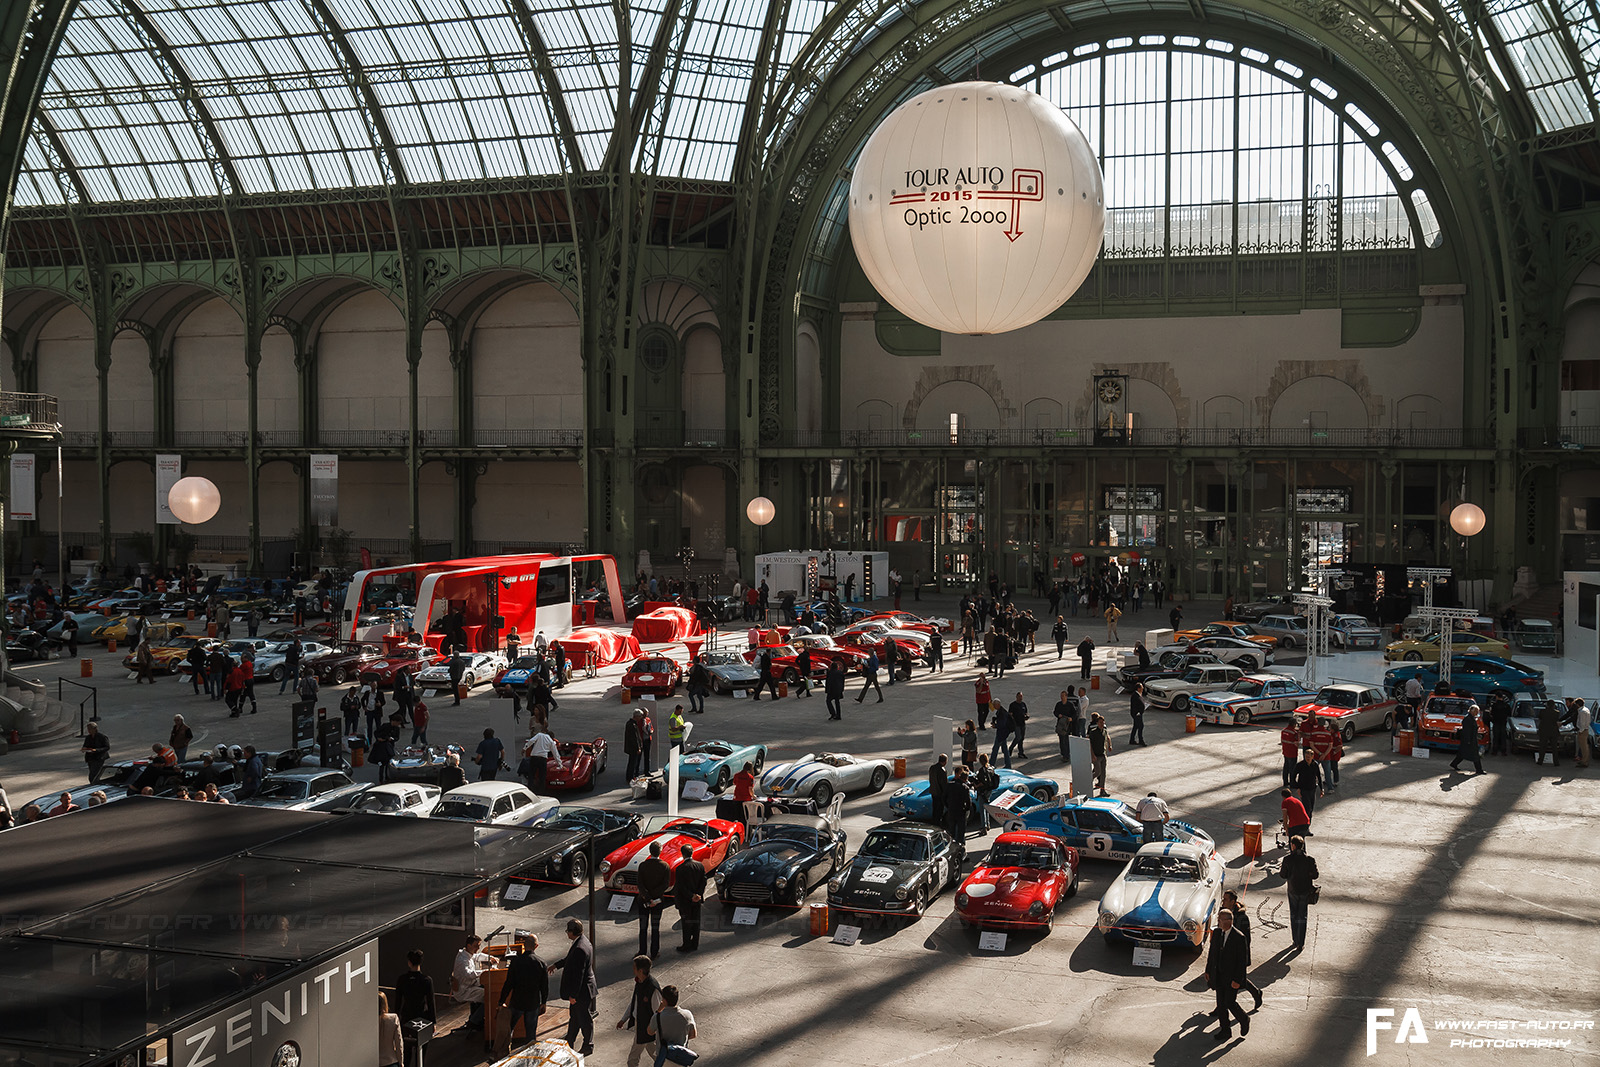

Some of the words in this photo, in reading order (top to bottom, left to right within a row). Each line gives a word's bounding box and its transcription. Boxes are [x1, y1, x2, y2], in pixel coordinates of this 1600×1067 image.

[904, 168, 949, 188] TOUR
[954, 166, 1004, 186] AUTO
[930, 190, 973, 202] 2015
[904, 207, 951, 230] Optic
[960, 205, 1007, 224] 2000
[1271, 700, 1280, 711] 24
[1010, 822, 1022, 833] 5
[1093, 837, 1105, 852] 5
[1108, 851, 1131, 860] LIGIER
[984, 900, 1012, 908] ZENITH
[185, 951, 371, 1067] ZENITH
